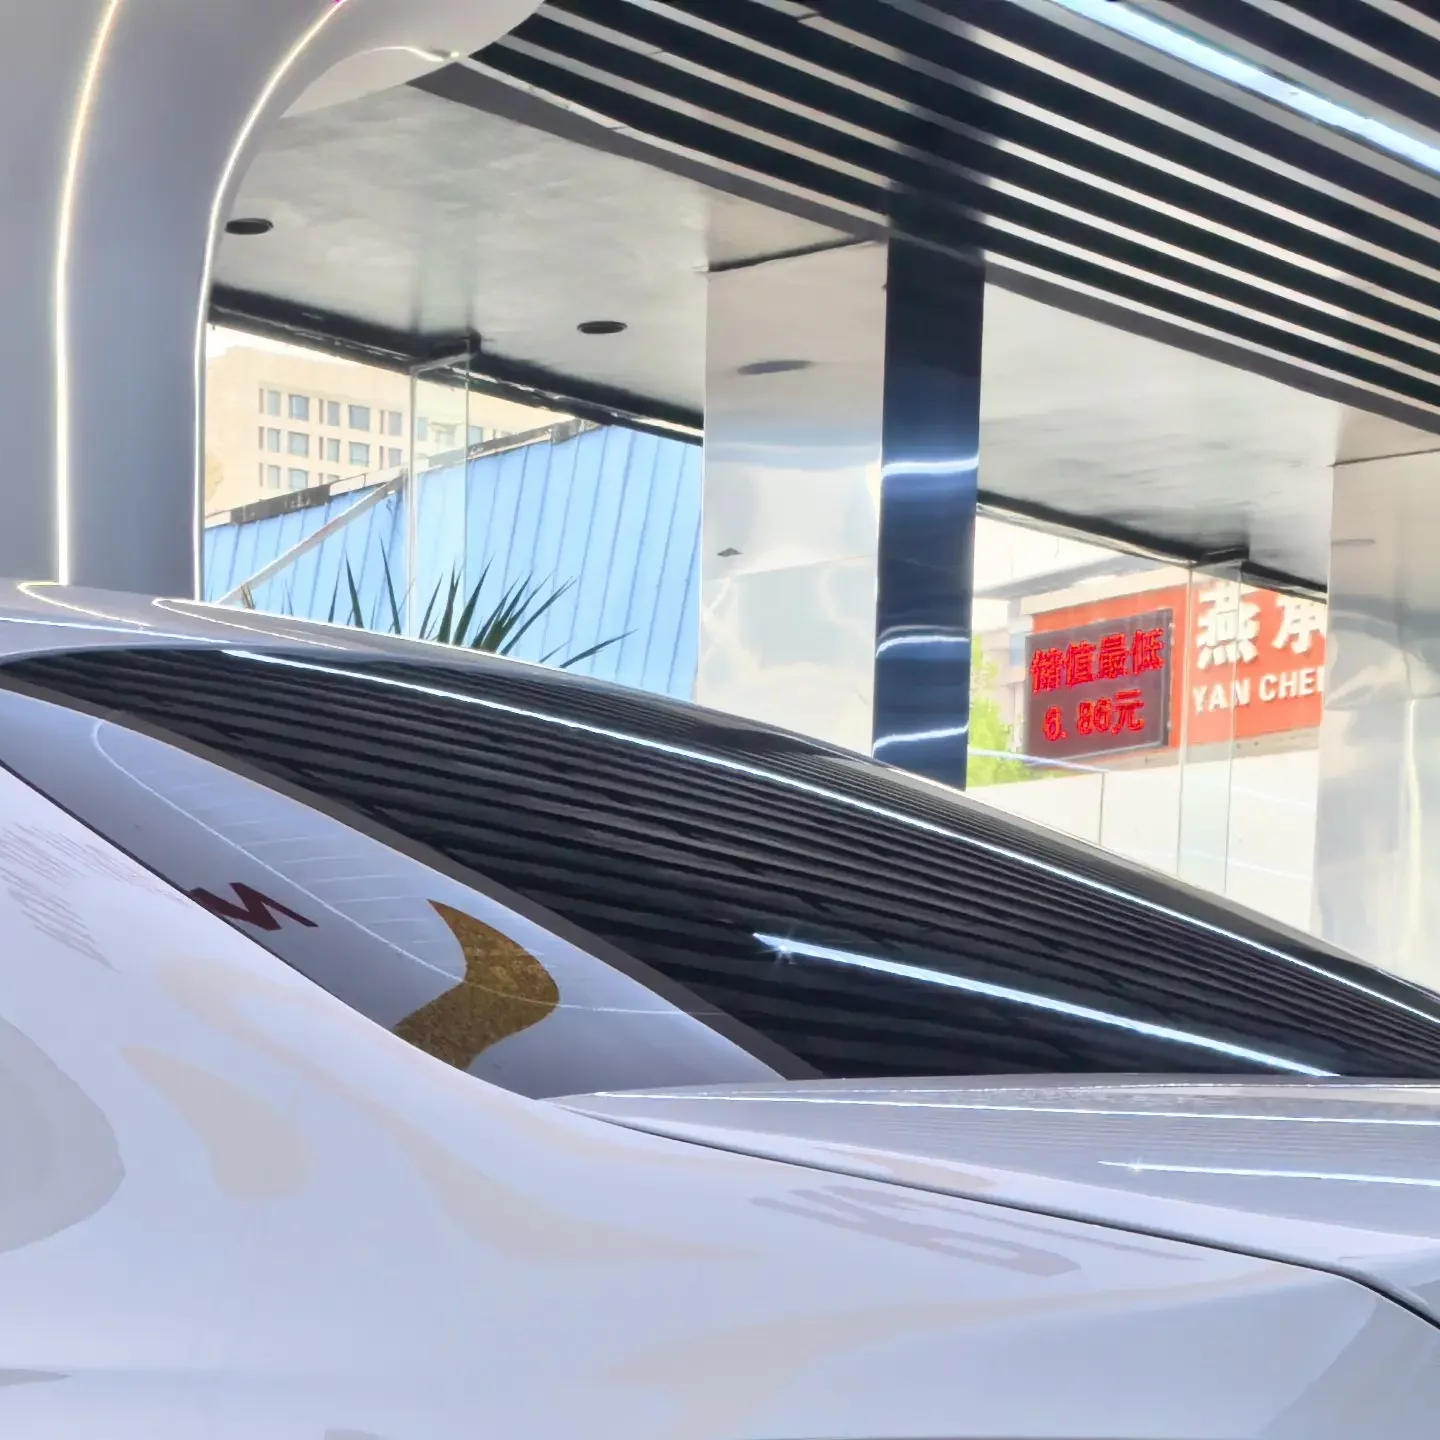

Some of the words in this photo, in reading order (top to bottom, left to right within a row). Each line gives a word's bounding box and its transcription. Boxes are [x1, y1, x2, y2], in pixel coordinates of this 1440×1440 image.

[1031, 628, 1164, 695] 储值最低
[1193, 678, 1252, 713] YAN
